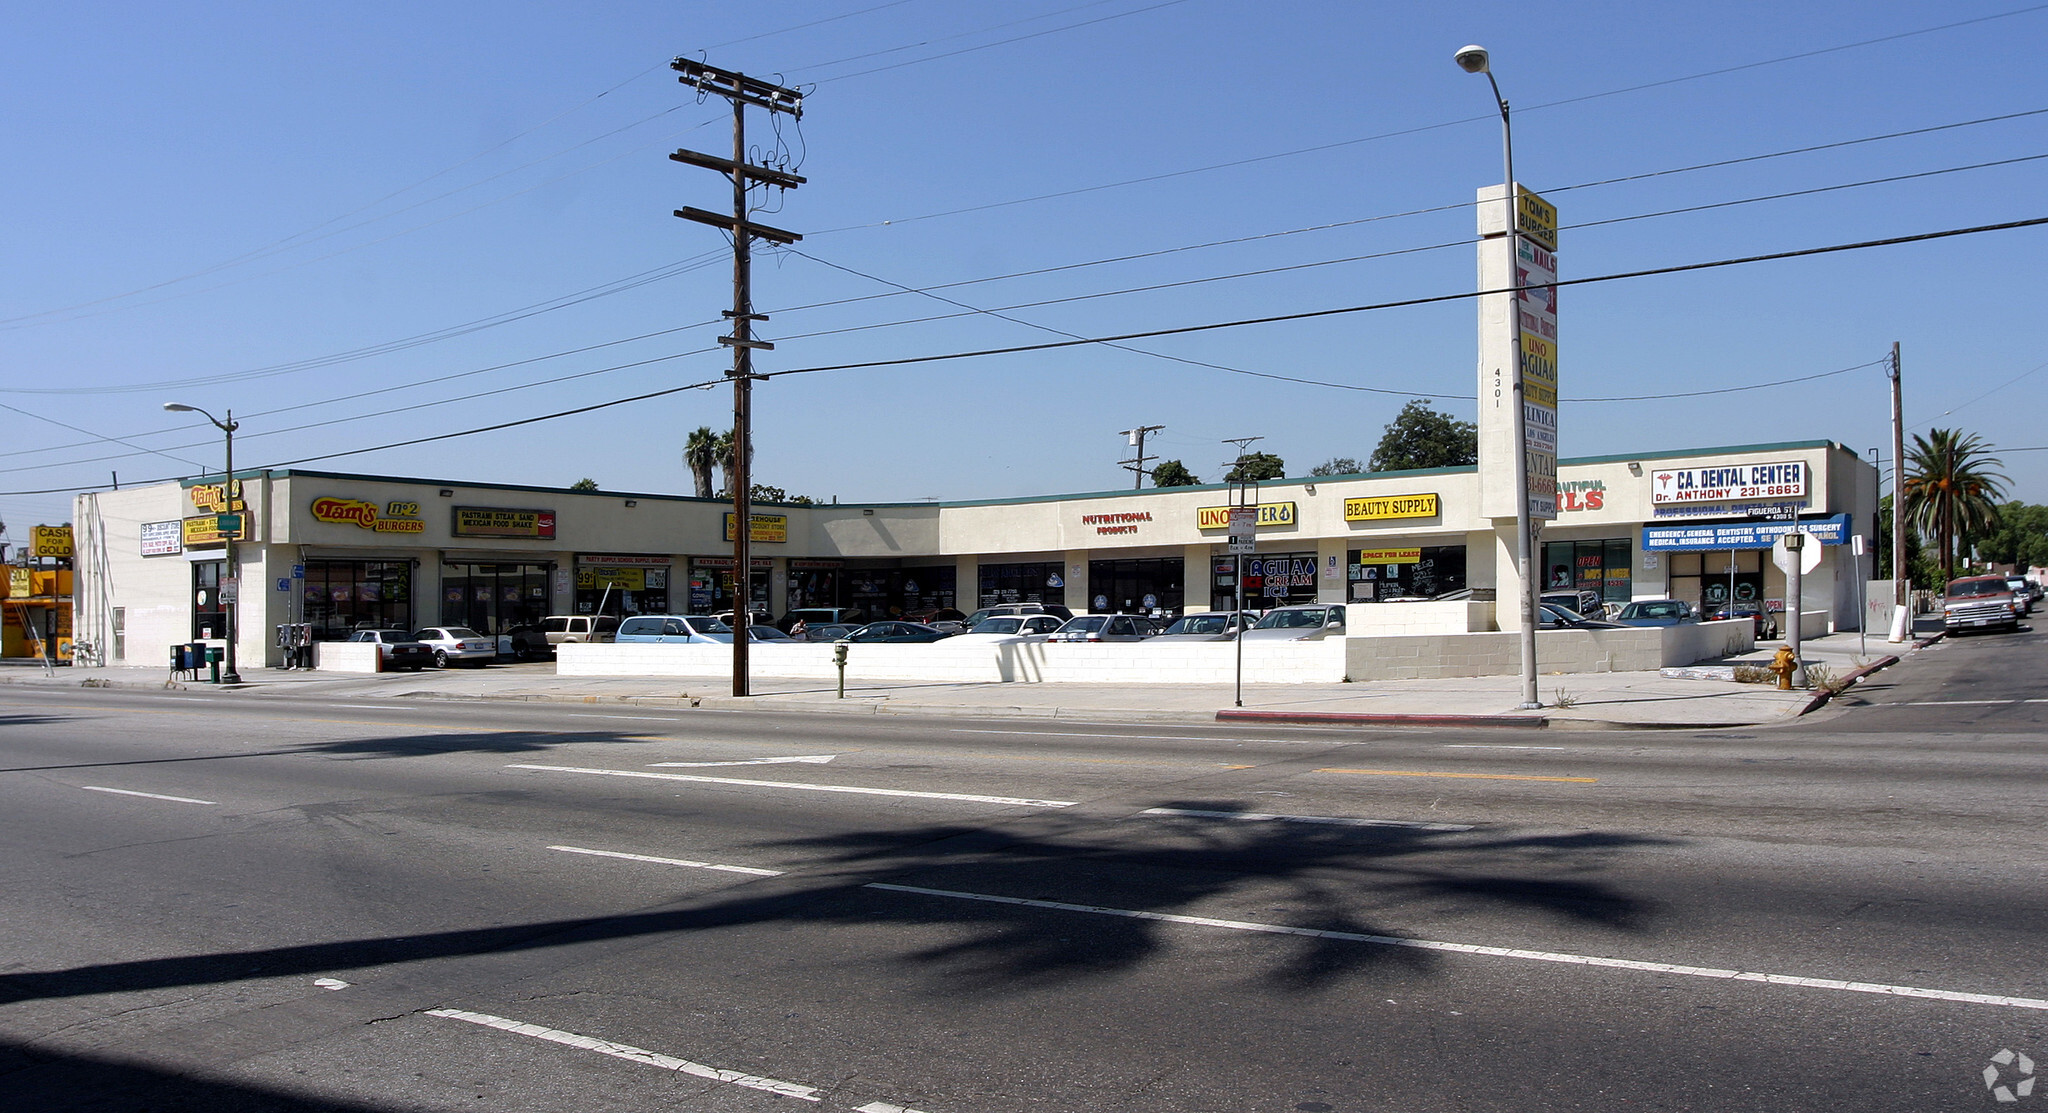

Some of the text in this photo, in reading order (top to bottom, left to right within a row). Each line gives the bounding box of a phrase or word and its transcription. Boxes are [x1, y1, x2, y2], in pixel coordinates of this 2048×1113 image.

[1519, 212, 1555, 243] BURGER
[1528, 338, 1547, 357] UNO
[1521, 351, 1549, 379] AGUA
[1524, 405, 1555, 428] LINICA
[1526, 452, 1556, 477] ENTAL
[1677, 464, 1800, 490] CA. DENTAL CENTER
[1527, 476, 1557, 495] 31-6663
[1557, 479, 1607, 493] AUTIFUL
[191, 487, 220, 511] Tam's
[1655, 484, 1800, 502] Dr. ANTHONY 231-6663
[1346, 498, 1435, 517] BEAUTY SUPPLY
[1557, 491, 1604, 512] ILS
[315, 500, 377, 527] Tam's
[495, 512, 516, 520] STEAK
[519, 513, 535, 521] SAND
[1200, 510, 1229, 525] UNO
[1255, 507, 1277, 522] TER
[1653, 504, 1728, 517] PROFESSIONAL
[1747, 506, 1782, 516] FIGUEROA
[463, 519, 492, 527] MEXICAN
[493, 520, 510, 528] FOOD
[512, 521, 533, 529] SHAKE
[1082, 511, 1154, 525] NUTRITIONAL
[39, 528, 71, 538] CASH
[377, 521, 424, 531] BURGERS
[1096, 525, 1139, 536] PRODUCTS
[1756, 524, 1808, 535] ORTHODONTCS
[1809, 523, 1842, 533] SURGERY
[39, 546, 71, 555] GOLD
[1250, 558, 1304, 577] AGUA
[1577, 556, 1602, 567] OPEN
[1265, 574, 1314, 587] CREAM
[1263, 586, 1289, 598] ICE
[1765, 600, 1783, 610] OPEN
